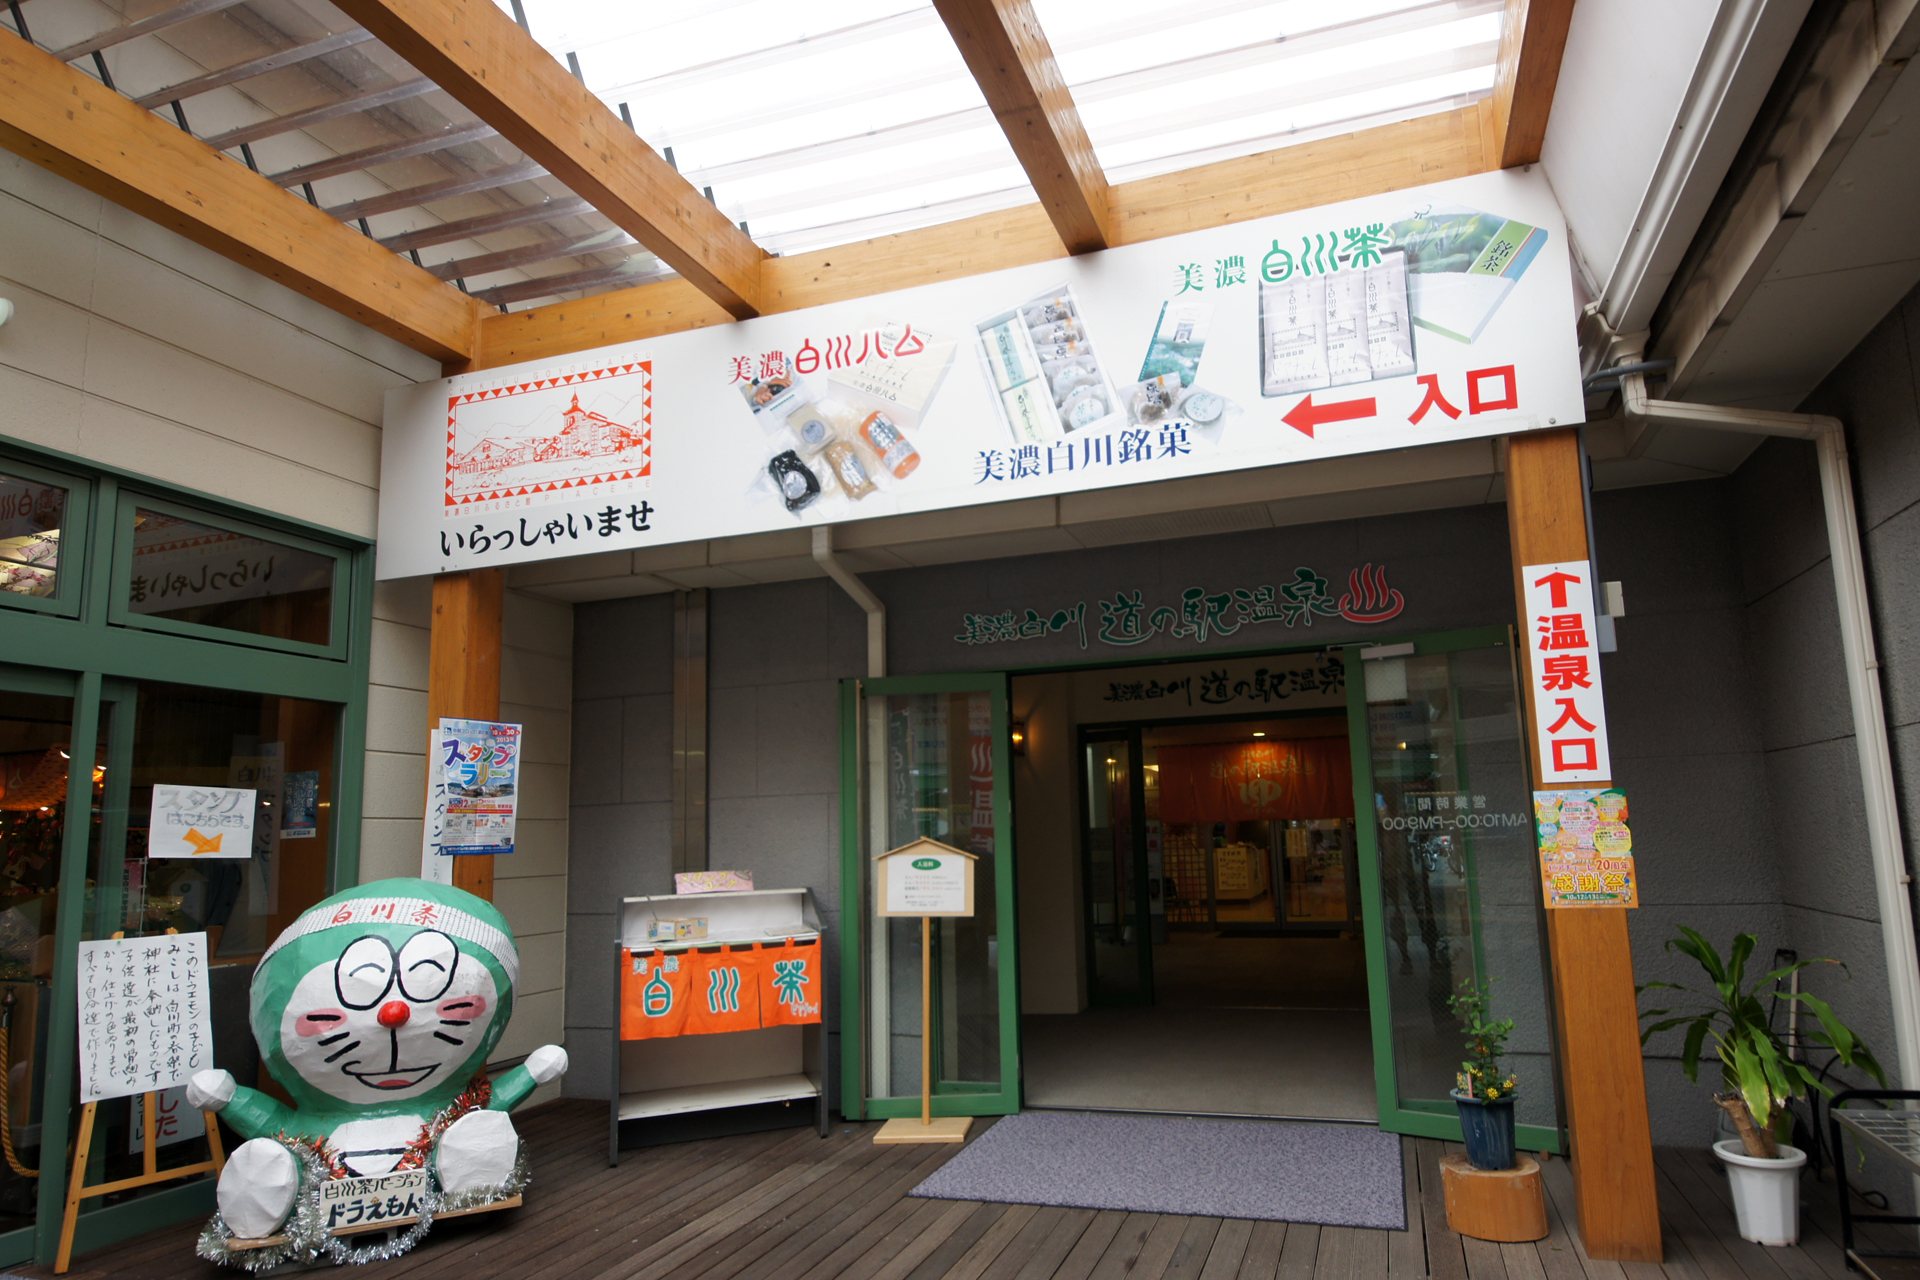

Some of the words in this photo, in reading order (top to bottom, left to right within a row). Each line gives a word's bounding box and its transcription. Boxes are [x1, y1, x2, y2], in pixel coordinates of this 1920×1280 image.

[534, 352, 651, 380] GOYOUTATSU
[1407, 364, 1519, 425] 入口
[973, 422, 1192, 485] 美濃白川銘菓
[440, 500, 654, 556] いらっしゃいませ
[1536, 613, 1599, 772] 温泉入口
[442, 739, 517, 767] スタンプ
[158, 789, 248, 813] スタンプ
[1554, 872, 1627, 893] 感謝祭
[332, 903, 438, 925] 白川茶
[633, 955, 679, 975] 美濃
[325, 1174, 424, 1199] 白川茶バージョン
[327, 1193, 423, 1227] ドラえもん
